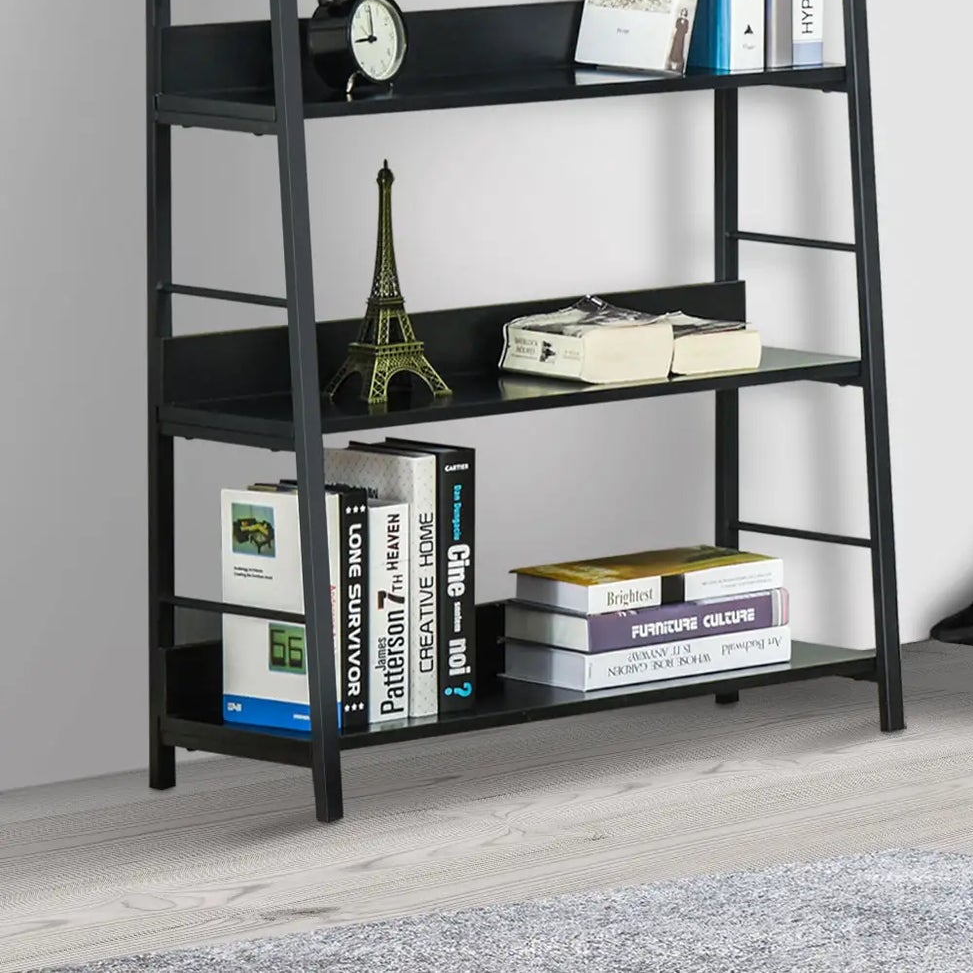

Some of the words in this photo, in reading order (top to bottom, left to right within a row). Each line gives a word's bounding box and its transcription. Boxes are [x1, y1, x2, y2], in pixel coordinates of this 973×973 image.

[348, 523, 362, 578] LONE
[386, 513, 401, 571] HEAVEN
[419, 512, 434, 567] HOME
[447, 544, 471, 598] Cine
[607, 588, 653, 607] Brightest
[347, 583, 362, 697] SURVIVOR
[419, 576, 434, 673] CREATIVE
[631, 616, 698, 639] FURNITURE
[703, 607, 755, 628] CULTURE
[375, 636, 388, 671] James
[380, 609, 405, 715] Patterson
[448, 637, 471, 676] noi
[650, 657, 675, 669] ROSE
[677, 652, 712, 666] WHOSE
[721, 638, 766, 656] Buchwald
[607, 661, 648, 678] GARDEN
